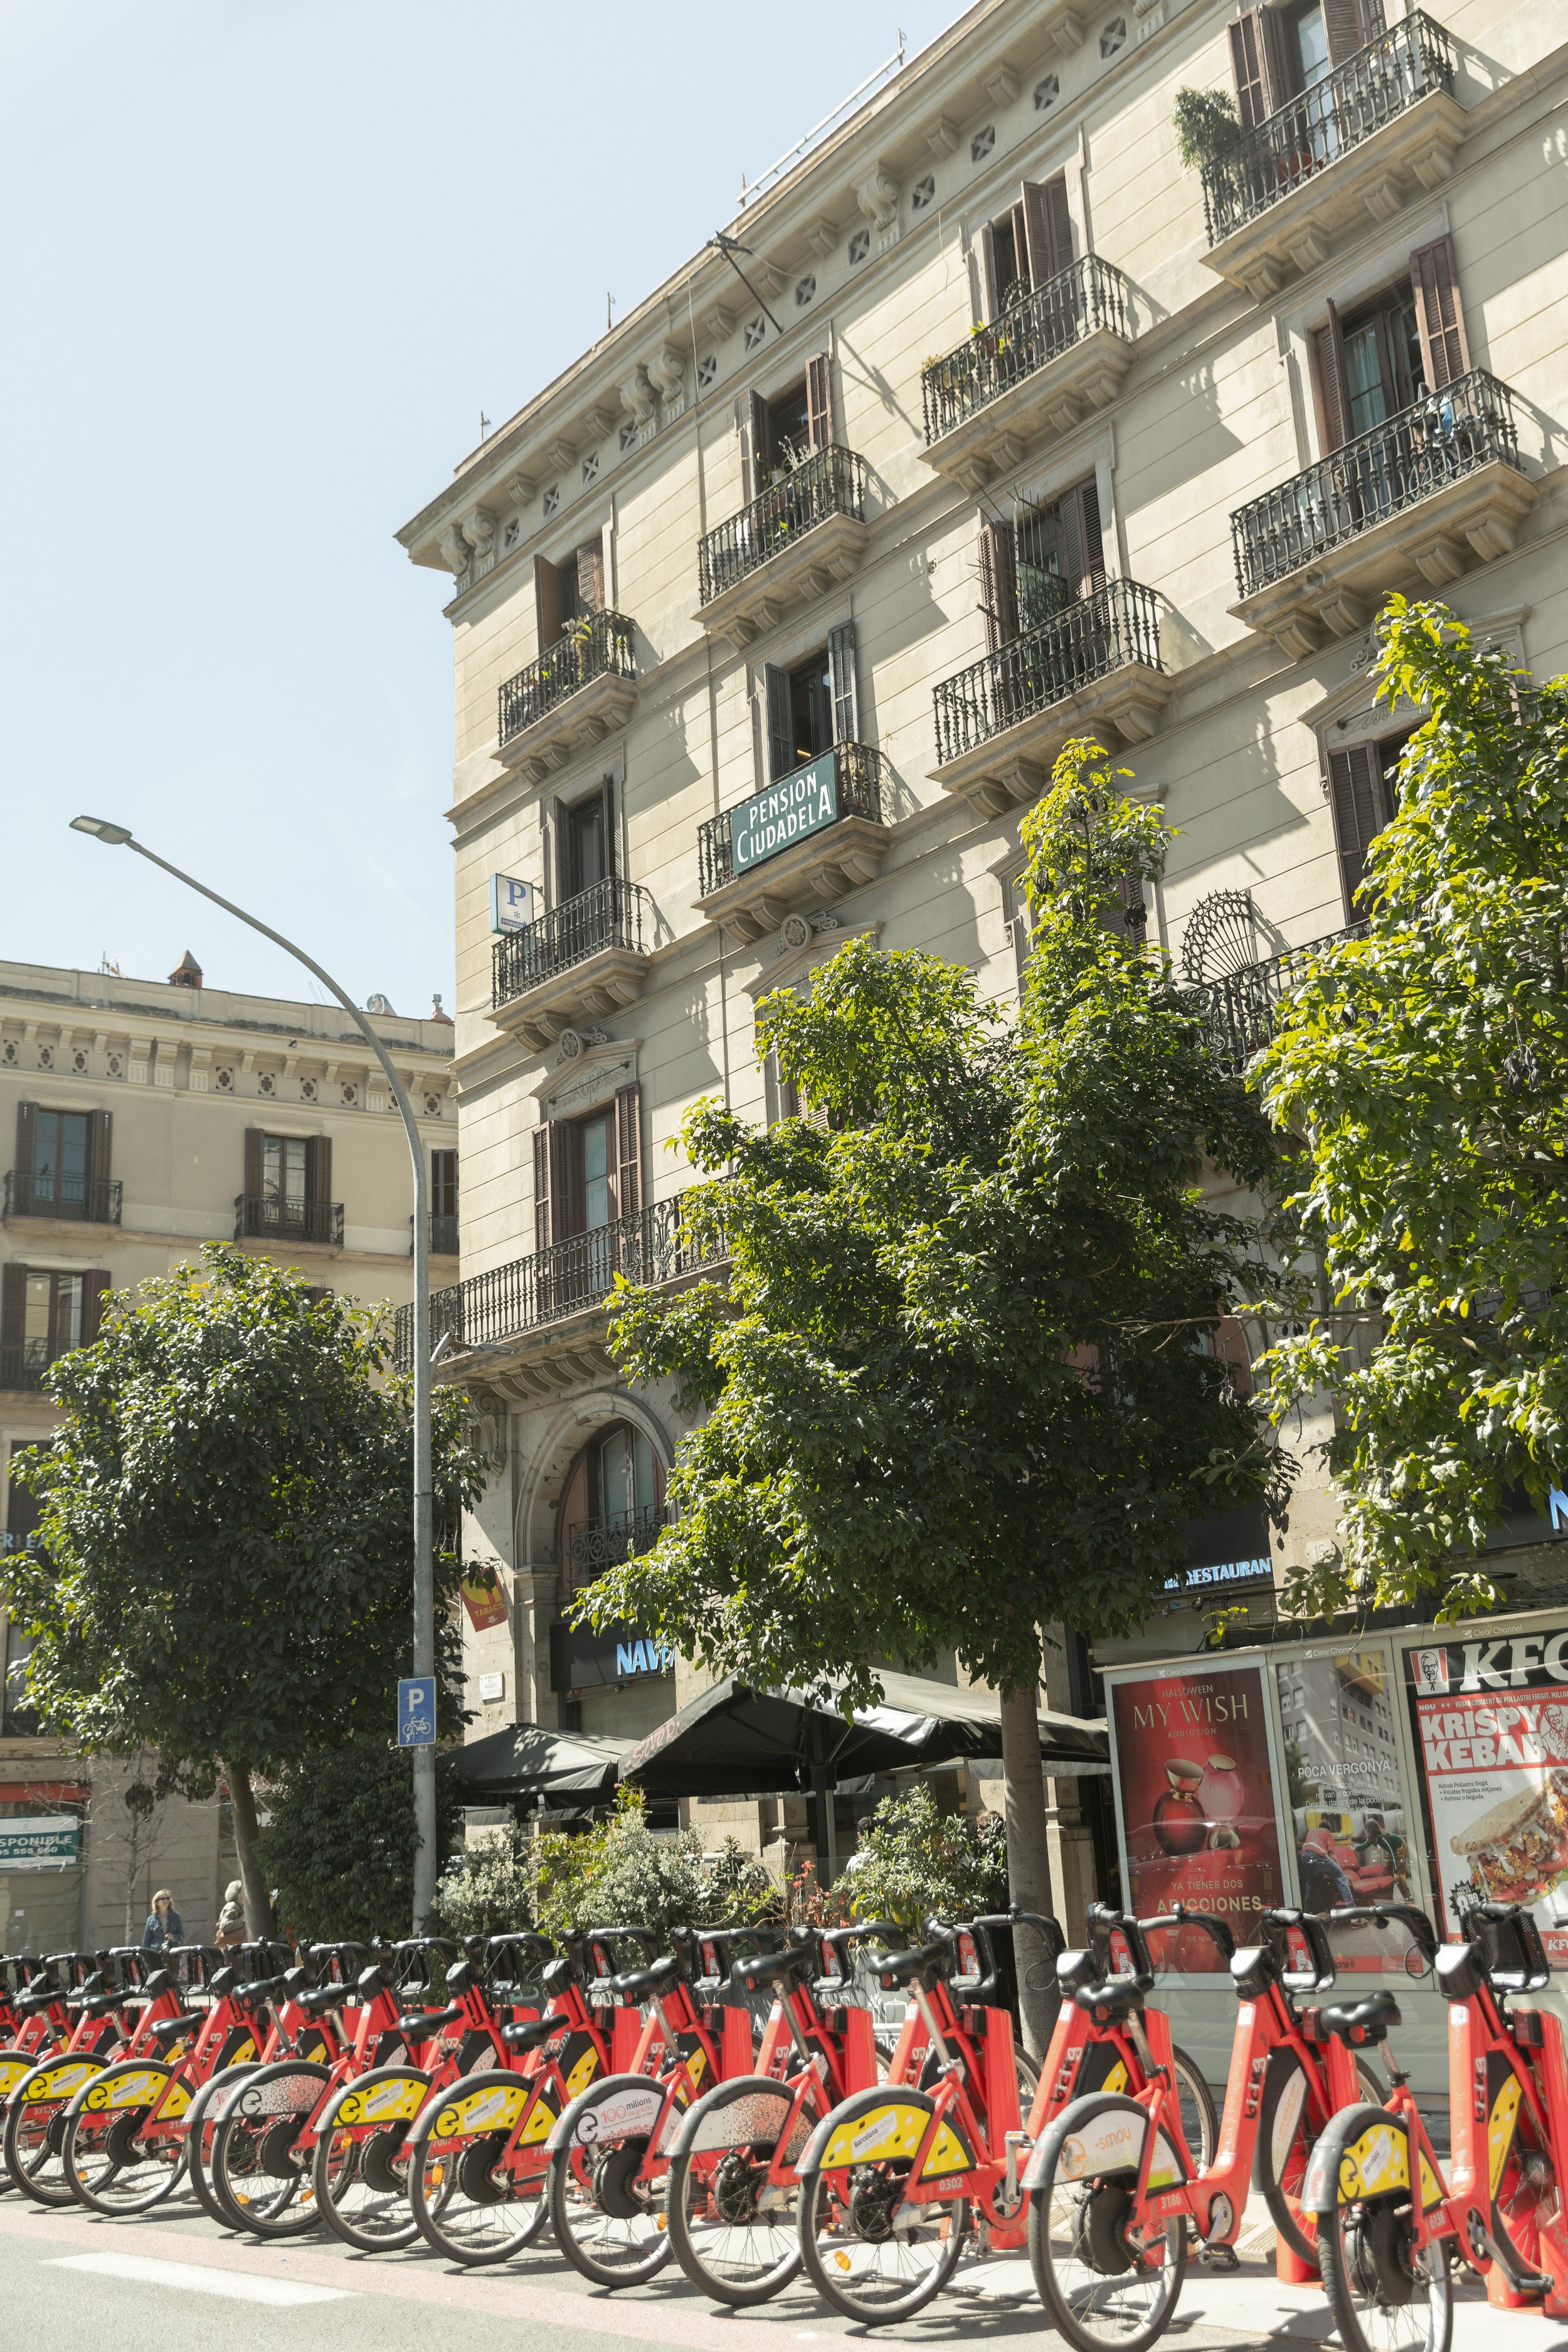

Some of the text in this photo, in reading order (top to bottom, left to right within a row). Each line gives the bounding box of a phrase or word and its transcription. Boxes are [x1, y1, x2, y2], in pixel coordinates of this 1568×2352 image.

[750, 771, 817, 829] PENSION
[737, 784, 832, 863] CIUDADELA
[507, 880, 526, 907] P
[502, 918, 524, 928] PENSION
[1185, 1557, 1272, 1586] RESTAURAN
[474, 1602, 504, 1618] TABACS
[1473, 1624, 1522, 1637] Clear Channel
[1167, 1666, 1205, 1677] Clear Channel
[1162, 1684, 1213, 1698] HALLOWEEN
[408, 1688, 425, 1713] P
[1455, 1700, 1471, 1708] KEBAB
[1471, 1698, 1495, 1706] CRUIXENT
[1503, 1695, 1532, 1703] POLLASTRE
[1134, 1694, 1248, 1730] MY WISH
[1420, 1704, 1541, 1741] KRISPY
[1167, 1727, 1217, 1739] ADDICTION
[1424, 1733, 1547, 1771] KEBAB
[1298, 1760, 1391, 1778] POCA VERGONYA
[1461, 1787, 1481, 1795] fregides
[1328, 1798, 1348, 1806] davant
[1365, 1796, 1390, 1805] porteria
[1172, 1880, 1243, 1890] YA TIENES DOS
[1457, 1883, 1470, 1892] MENÚ
[1547, 1937, 1568, 1951] KF
[1051, 2047, 1083, 2102] bicing
[114, 2084, 133, 2097] Barcelona
[1244, 2057, 1266, 2119] bicing
[1475, 2057, 1486, 2123] bicing
[367, 2094, 388, 2109] Barcelona
[627, 2097, 652, 2110] milions
[466, 2104, 489, 2121] Barcelona
[635, 2104, 654, 2116] gràcies
[854, 2127, 879, 2148] Barcelona
[1098, 2126, 1131, 2151] smou
[1364, 2149, 1380, 2174] Barcelona
[939, 2177, 963, 2191] 0302
[1161, 2193, 1181, 2209] 3186
[1429, 2210, 1446, 2229] 6138
